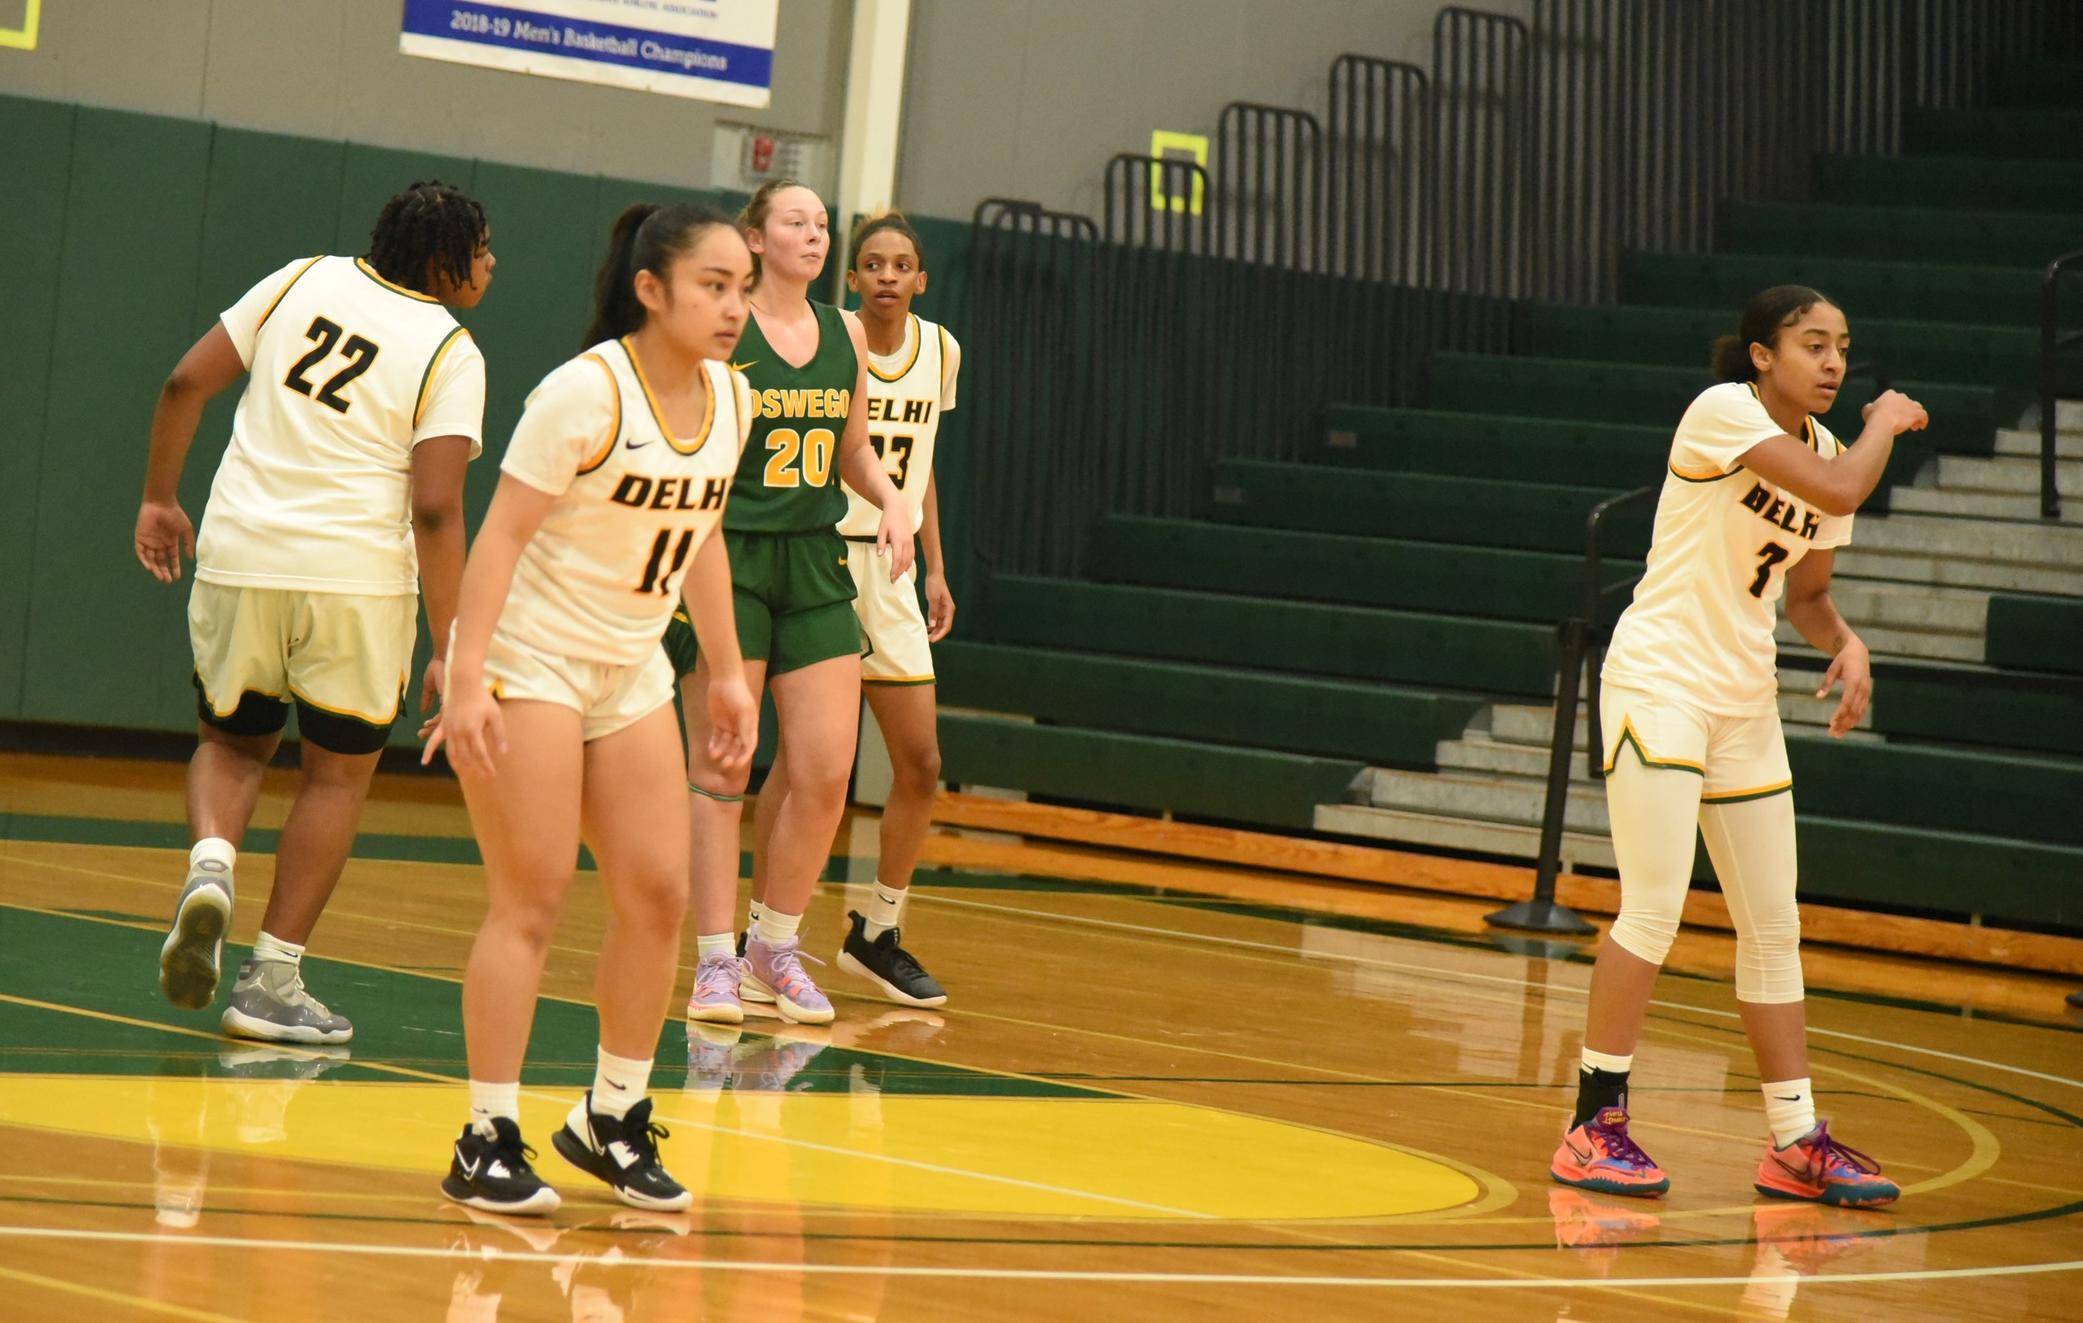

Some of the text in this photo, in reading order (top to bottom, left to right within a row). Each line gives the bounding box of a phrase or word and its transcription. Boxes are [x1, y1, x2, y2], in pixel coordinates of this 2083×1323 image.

[450, 10, 728, 71] 2018-19 Men's Basketball Champions
[283, 315, 380, 415] 22
[750, 388, 850, 419] OSWEGO
[867, 397, 933, 424] ELHI
[763, 427, 835, 488] 20
[609, 473, 730, 511] DELH
[1739, 480, 1820, 541] DELH
[634, 528, 695, 596] 11
